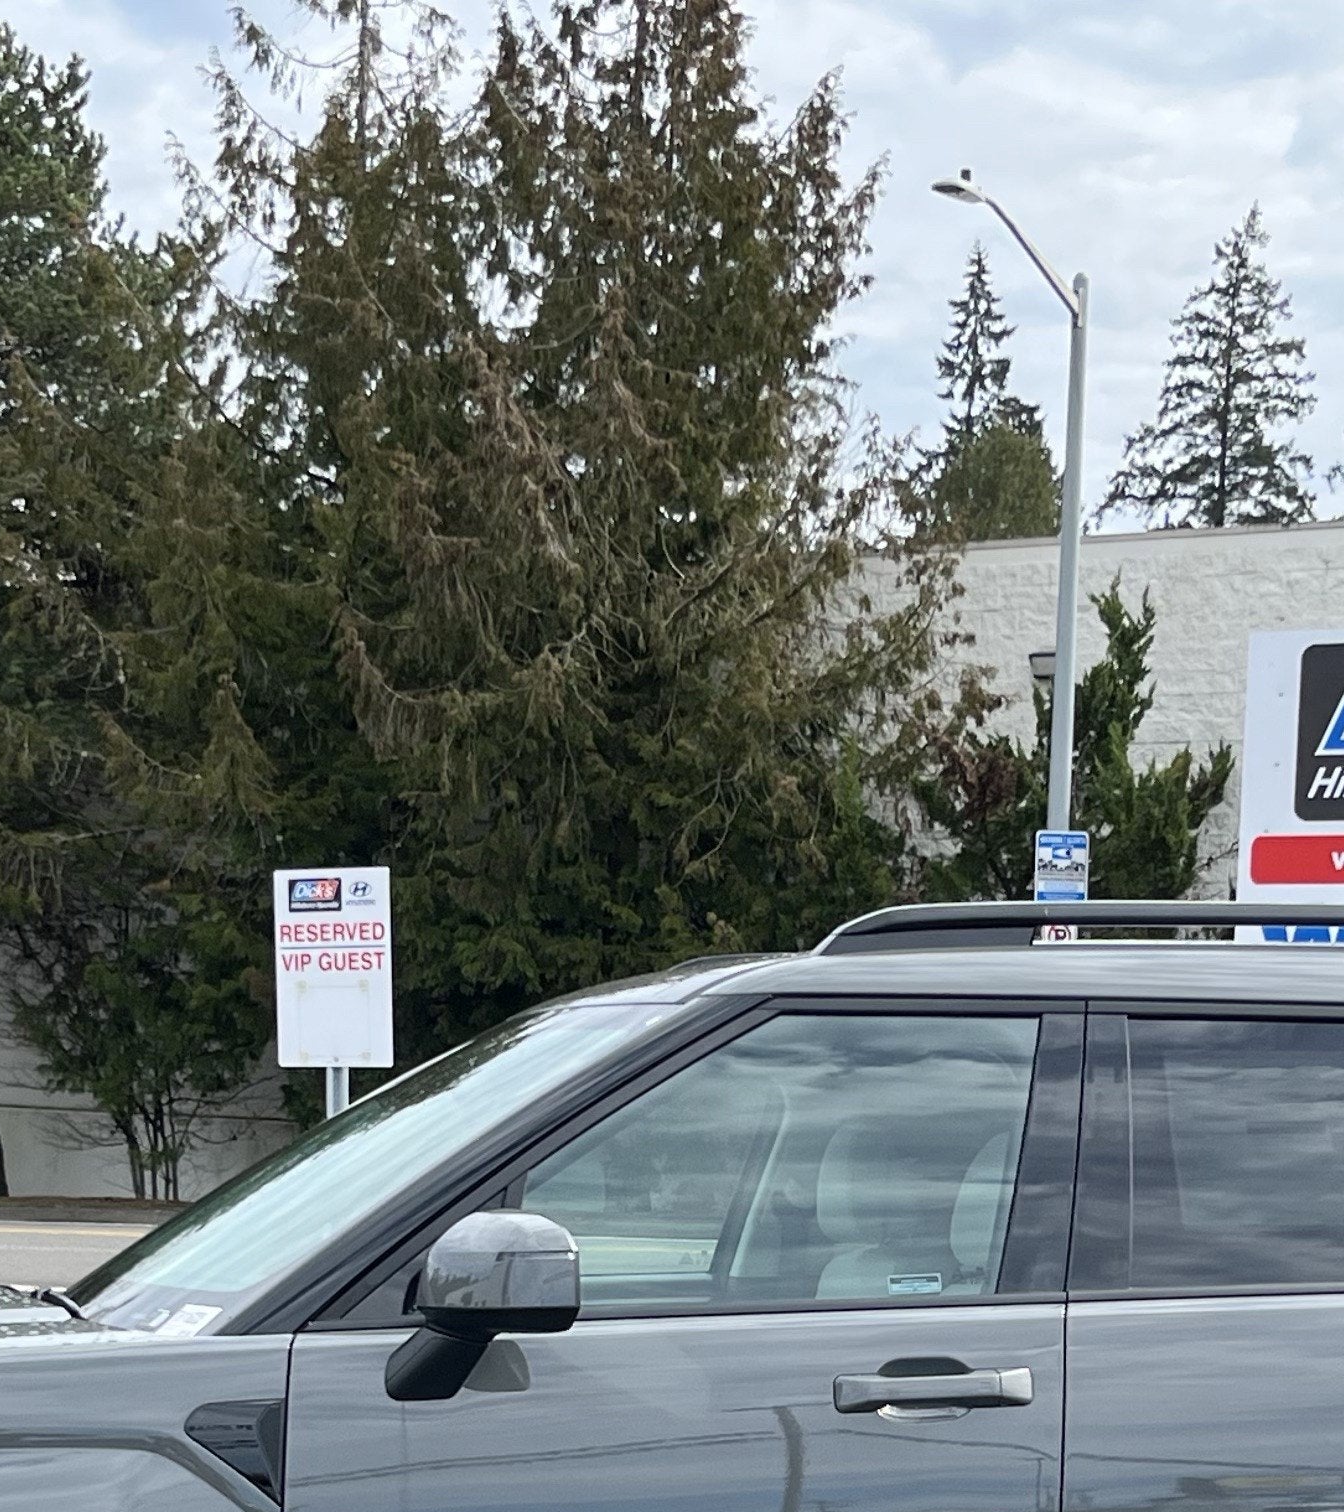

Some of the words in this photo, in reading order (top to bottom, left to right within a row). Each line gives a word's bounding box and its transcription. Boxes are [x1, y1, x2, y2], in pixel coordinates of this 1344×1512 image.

[279, 922, 385, 943] RESERVED
[281, 953, 312, 972] VIP
[318, 951, 385, 971] GUEST
